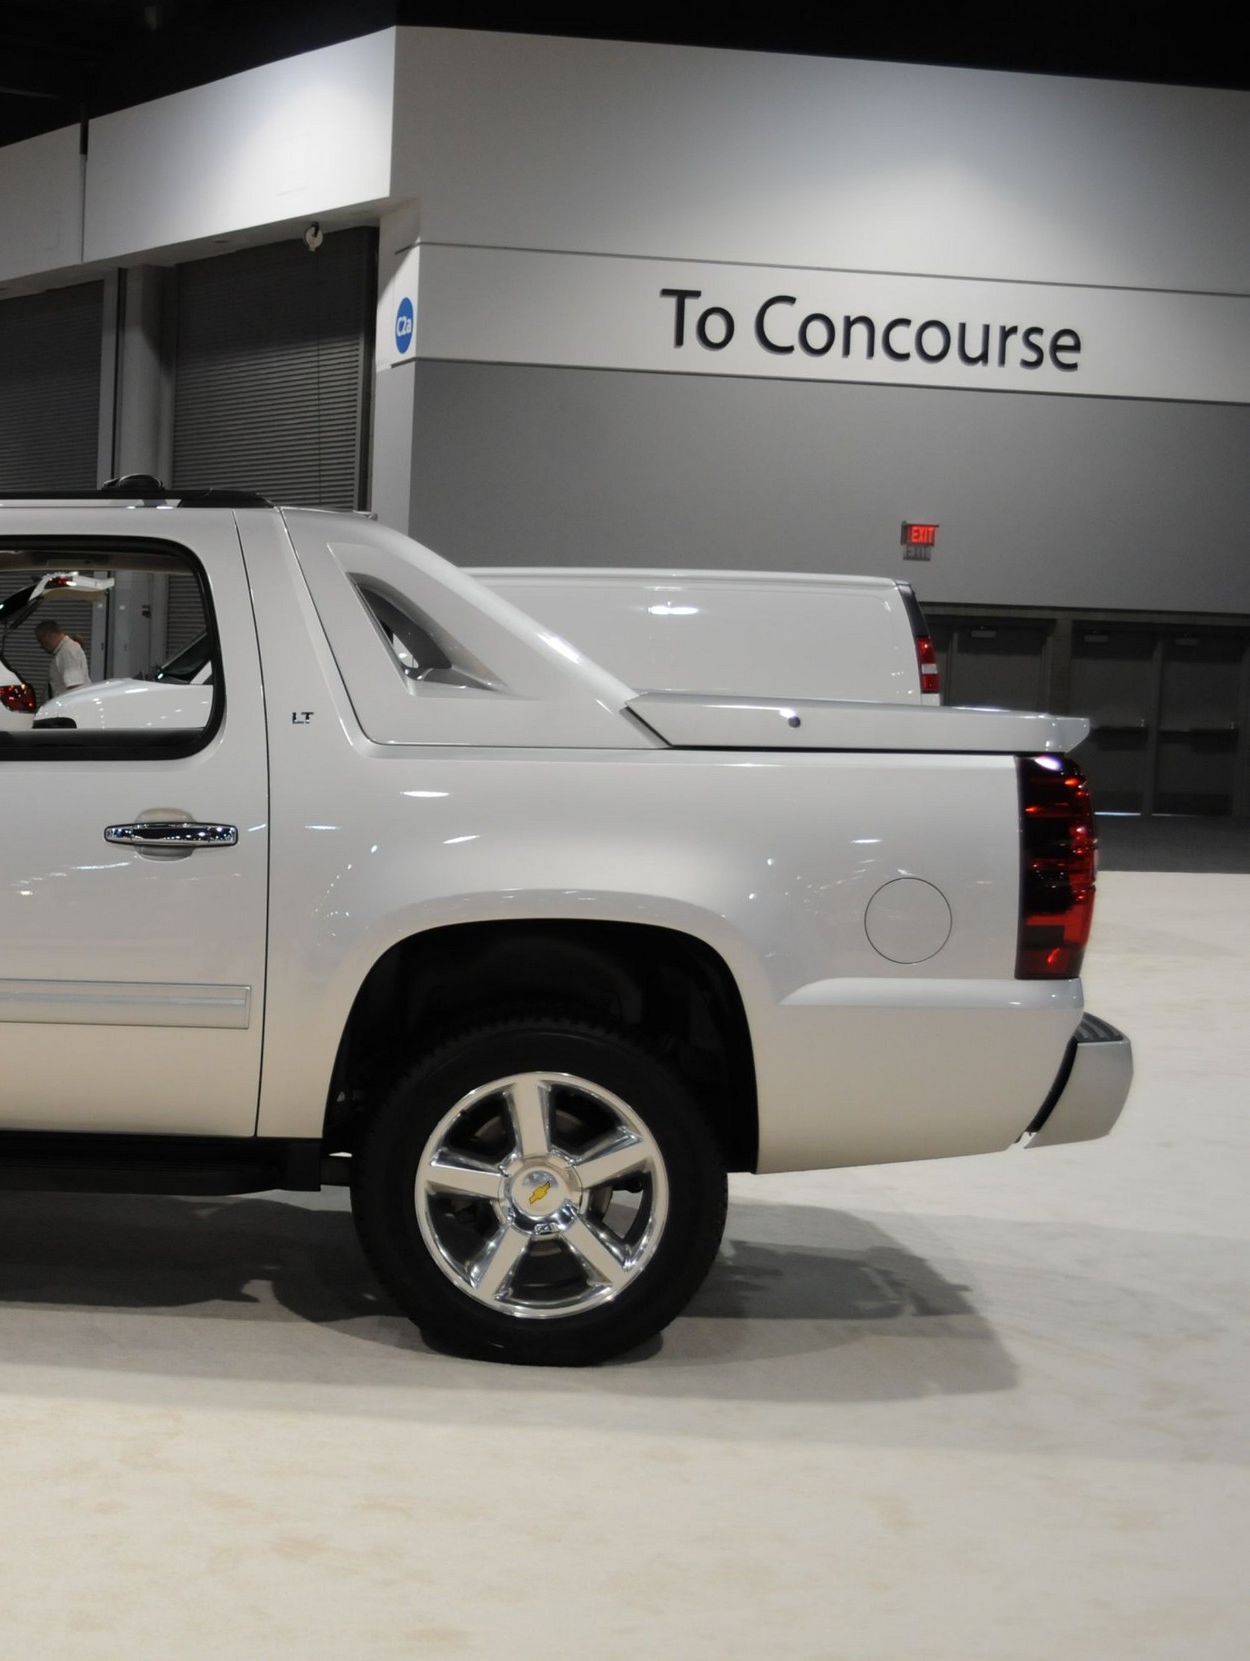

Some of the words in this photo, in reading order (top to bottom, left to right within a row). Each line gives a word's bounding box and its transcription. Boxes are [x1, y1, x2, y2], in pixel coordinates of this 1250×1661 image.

[659, 288, 736, 351] To
[754, 295, 1082, 372] Concourse
[910, 526, 936, 544] EXIT
[292, 711, 314, 724] LT
